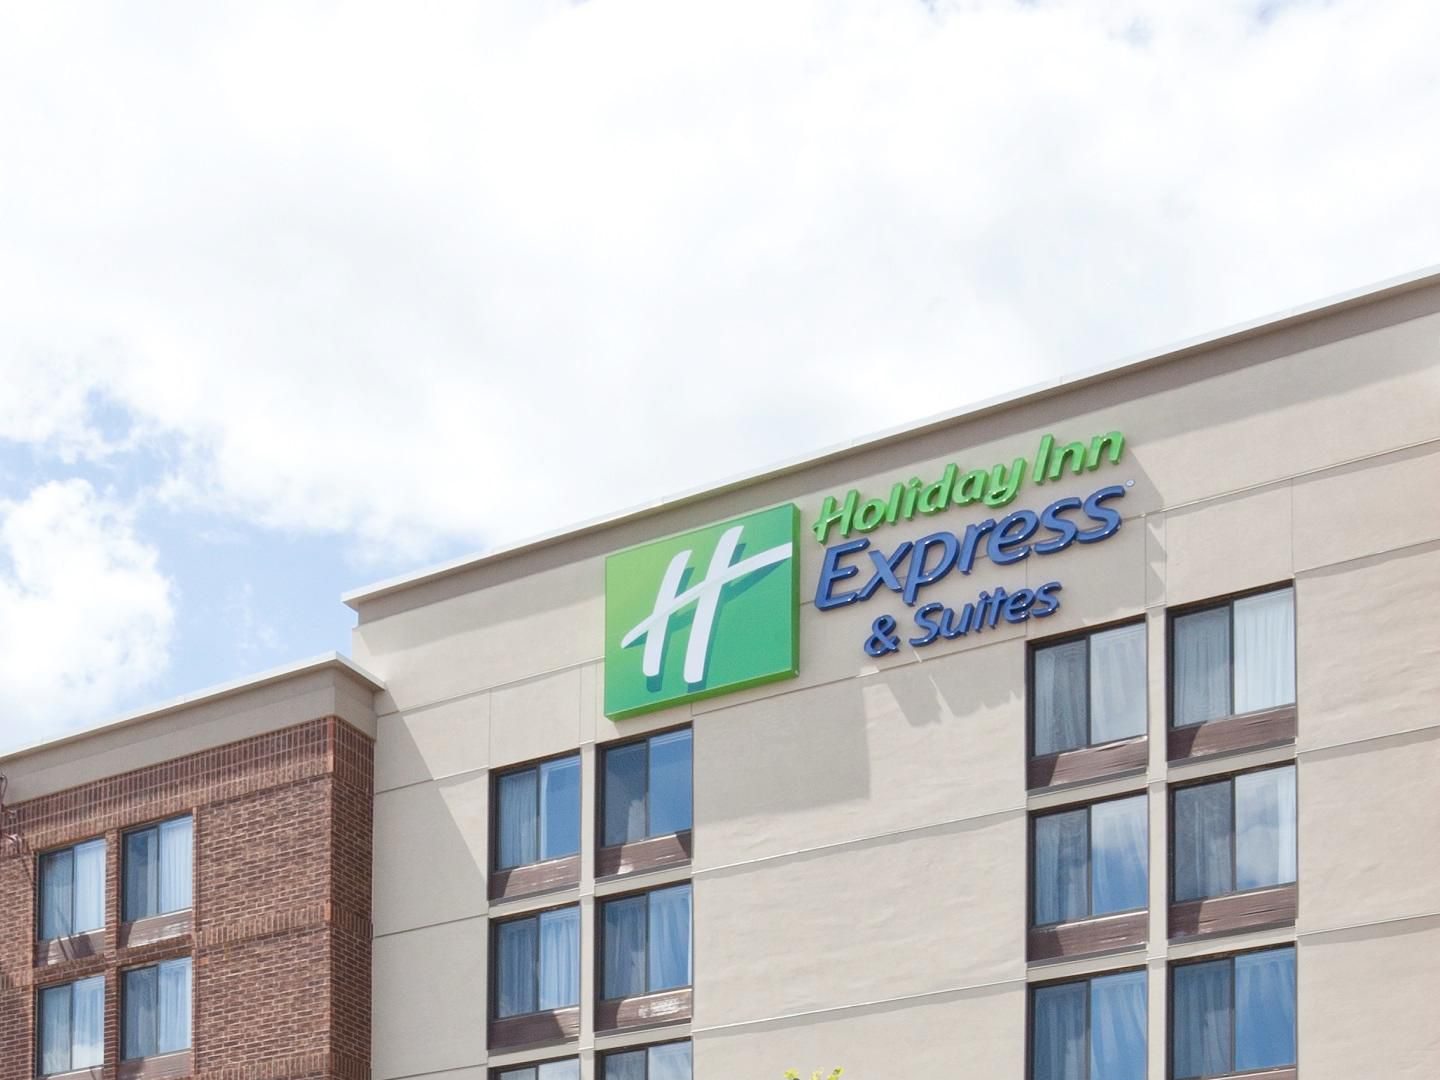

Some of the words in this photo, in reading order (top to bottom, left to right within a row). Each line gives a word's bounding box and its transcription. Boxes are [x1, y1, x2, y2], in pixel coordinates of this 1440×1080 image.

[812, 457, 1027, 544] Holiday
[1032, 430, 1126, 486] Inn
[814, 484, 1126, 612] Express
[863, 614, 900, 658] &
[909, 581, 1063, 648] Suites
